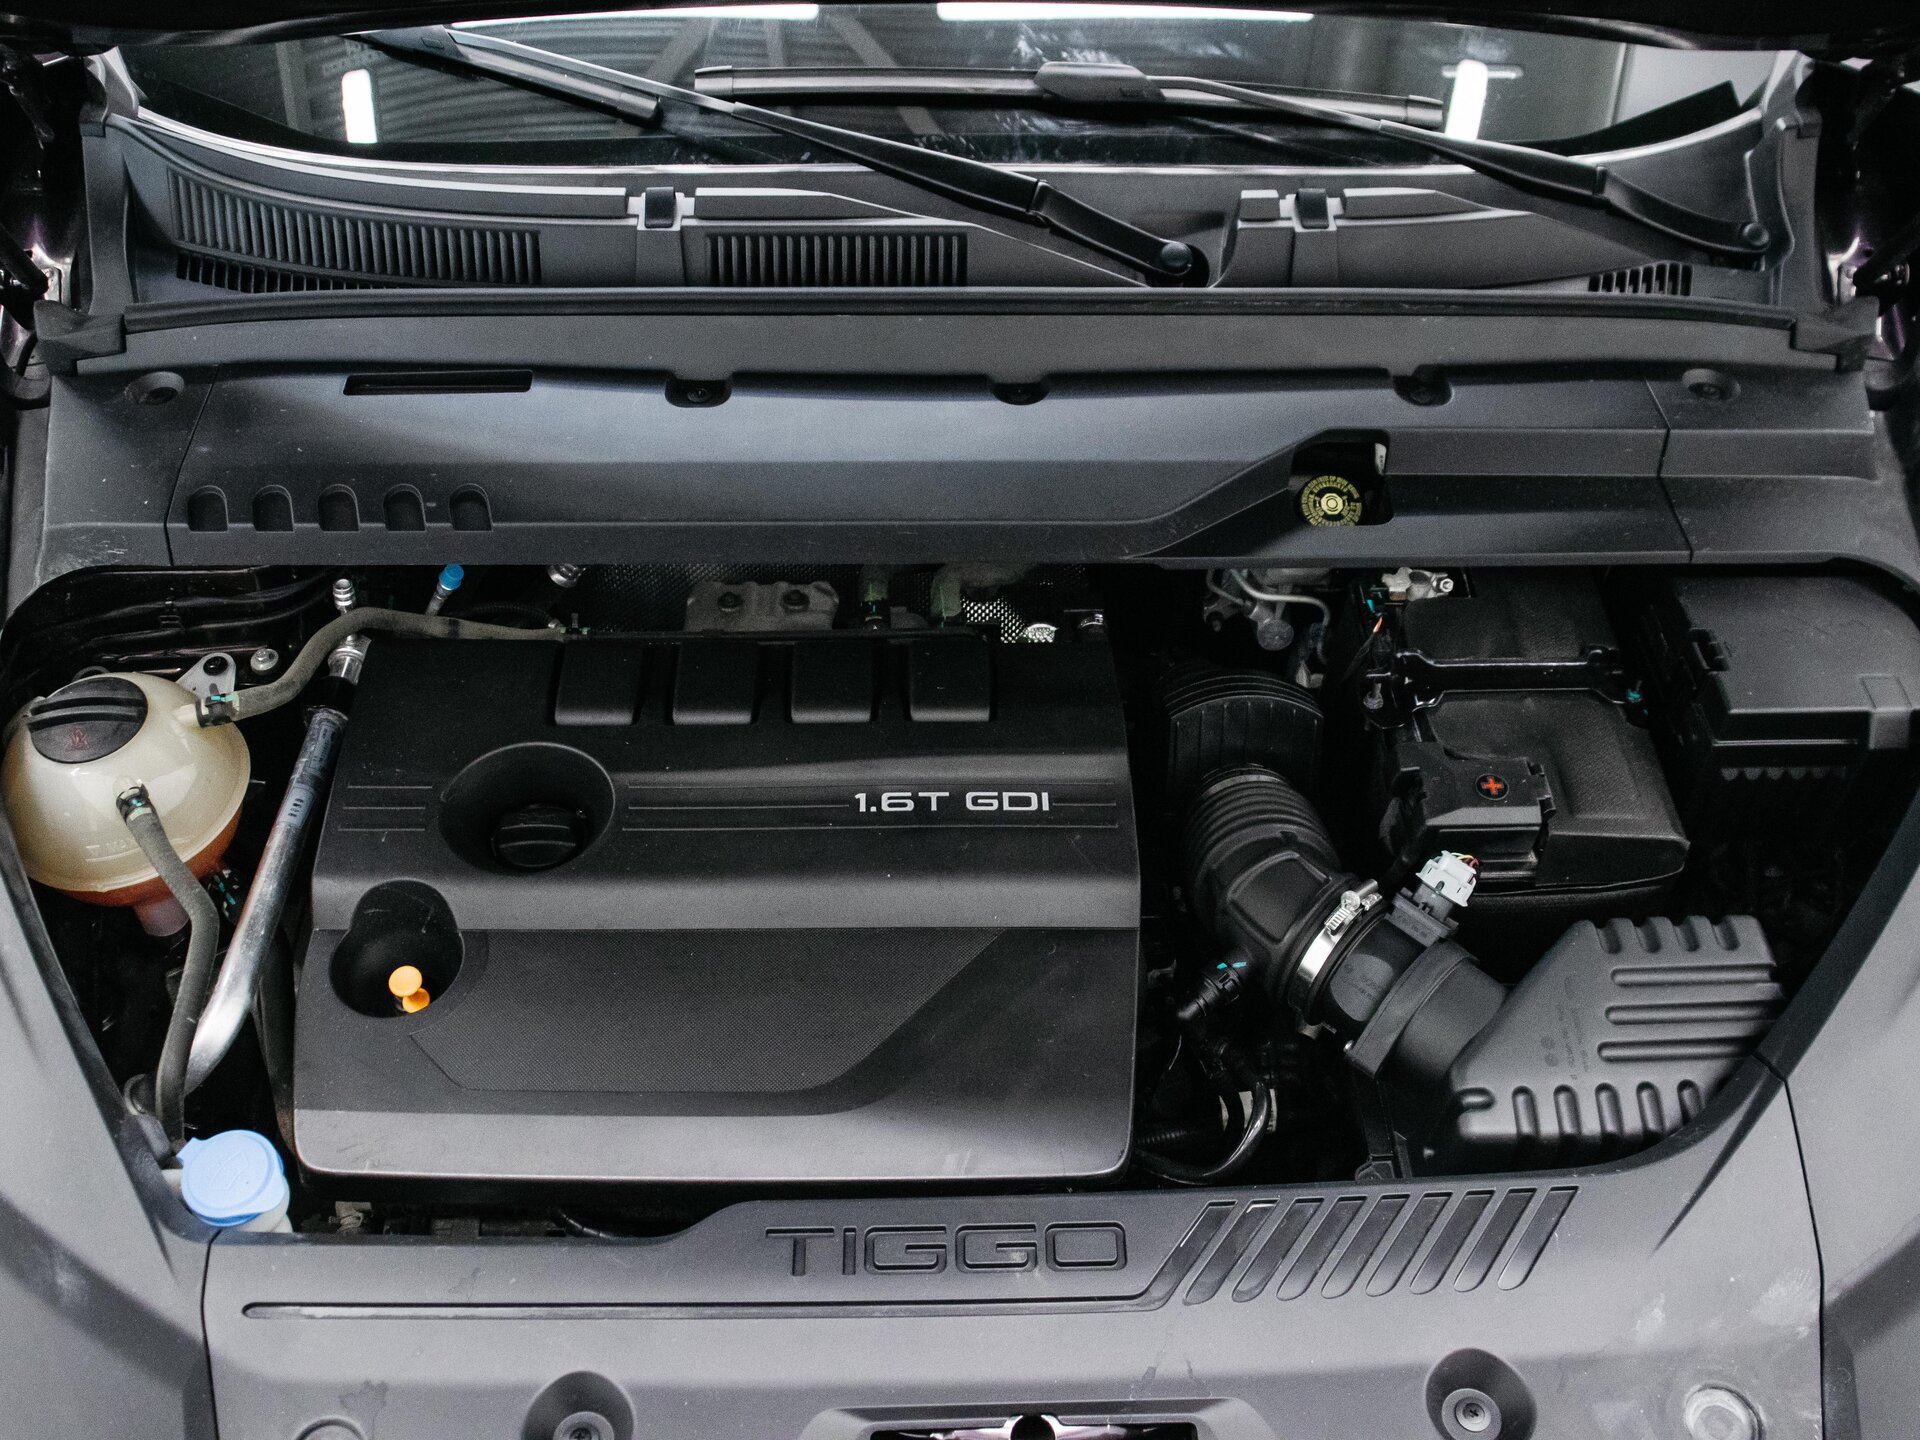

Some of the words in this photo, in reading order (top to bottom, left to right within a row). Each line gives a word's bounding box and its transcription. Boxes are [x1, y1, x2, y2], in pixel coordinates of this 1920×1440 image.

[854, 791, 950, 813] 1.6T
[965, 791, 1051, 812] GDI
[765, 1221, 1128, 1277] TIGGO
